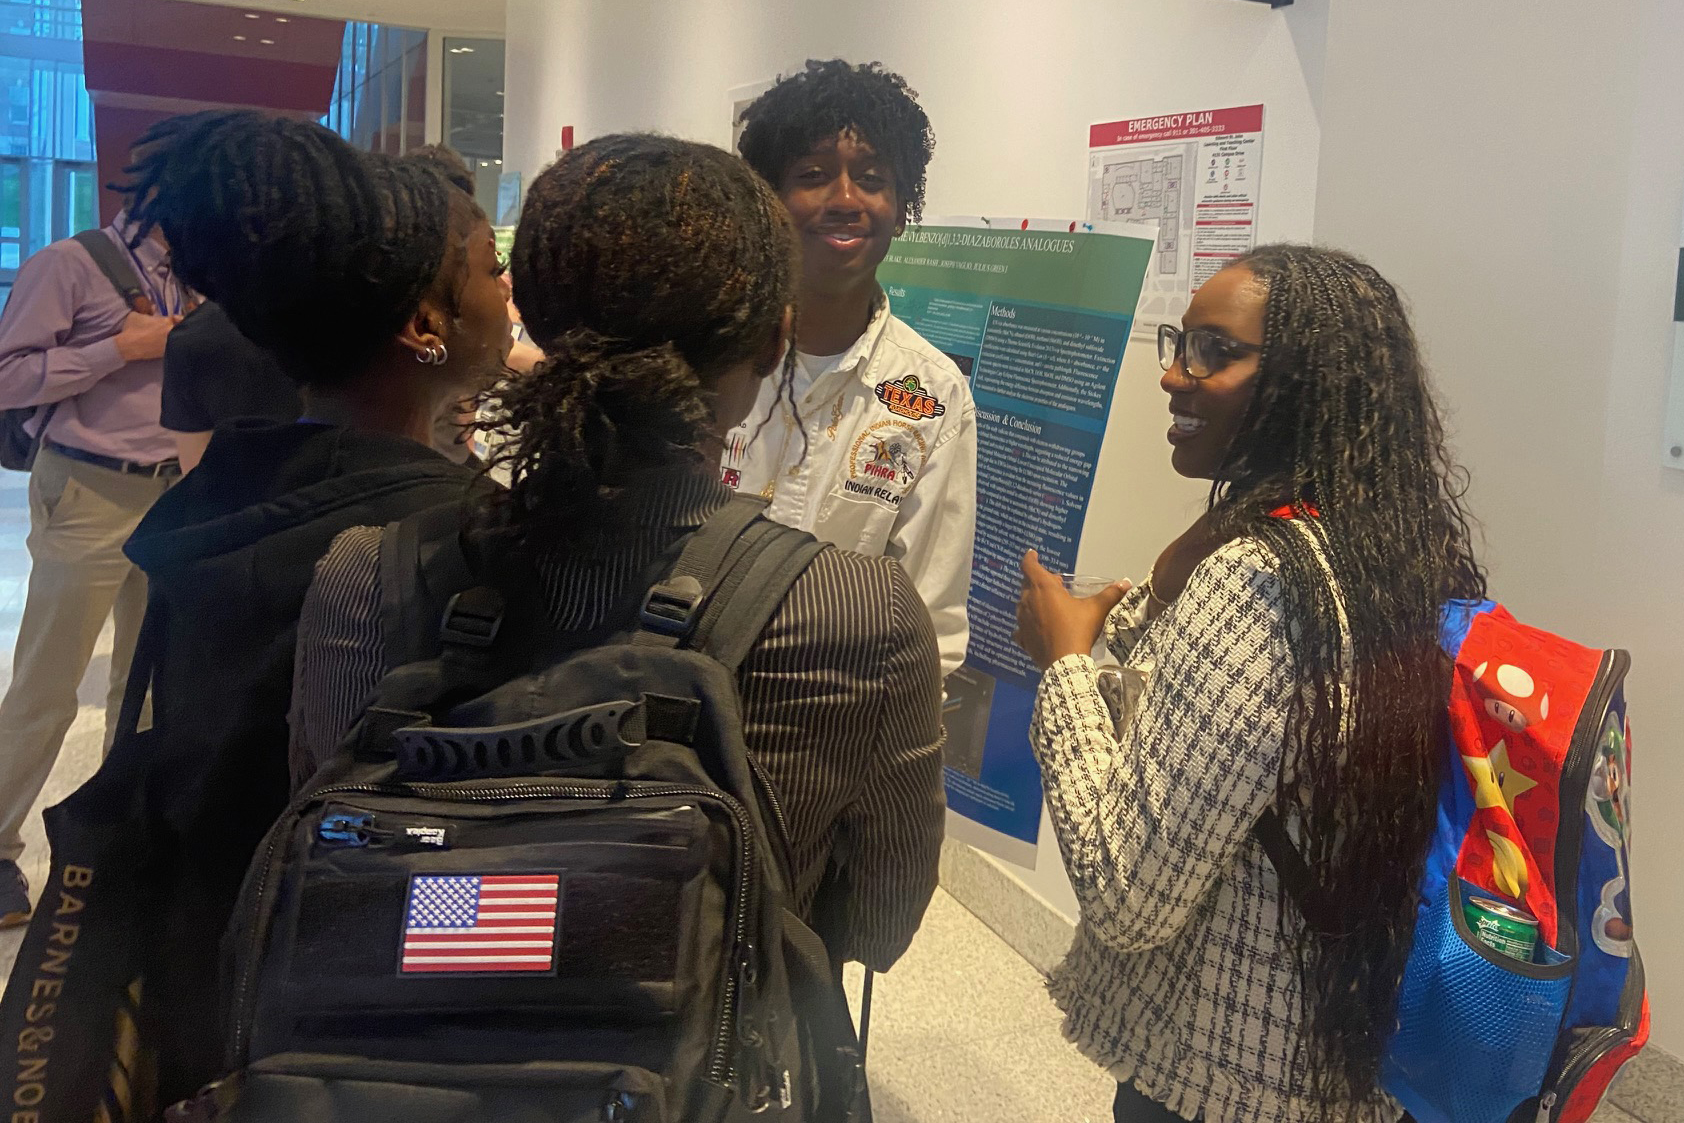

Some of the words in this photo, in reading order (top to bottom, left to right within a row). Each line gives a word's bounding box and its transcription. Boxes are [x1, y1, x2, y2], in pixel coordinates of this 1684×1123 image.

[1128, 115, 1184, 132] EMERGENCY
[1186, 112, 1213, 126] PLAN
[1139, 131, 1162, 140] emergency
[1019, 238, 1074, 253] ANALOGUES
[889, 286, 906, 298] Results
[991, 305, 1016, 319] Methods
[882, 386, 935, 416] TEXAS
[976, 407, 1001, 423] iscussion
[1002, 414, 1008, 425] &
[1010, 416, 1041, 435] Conclusion
[849, 430, 871, 480] PROFESSIONAL
[869, 419, 892, 432] INDIAN
[864, 463, 896, 481] PIHRA
[844, 480, 874, 496] INDIAN
[1481, 930, 1506, 944] Nutrition
